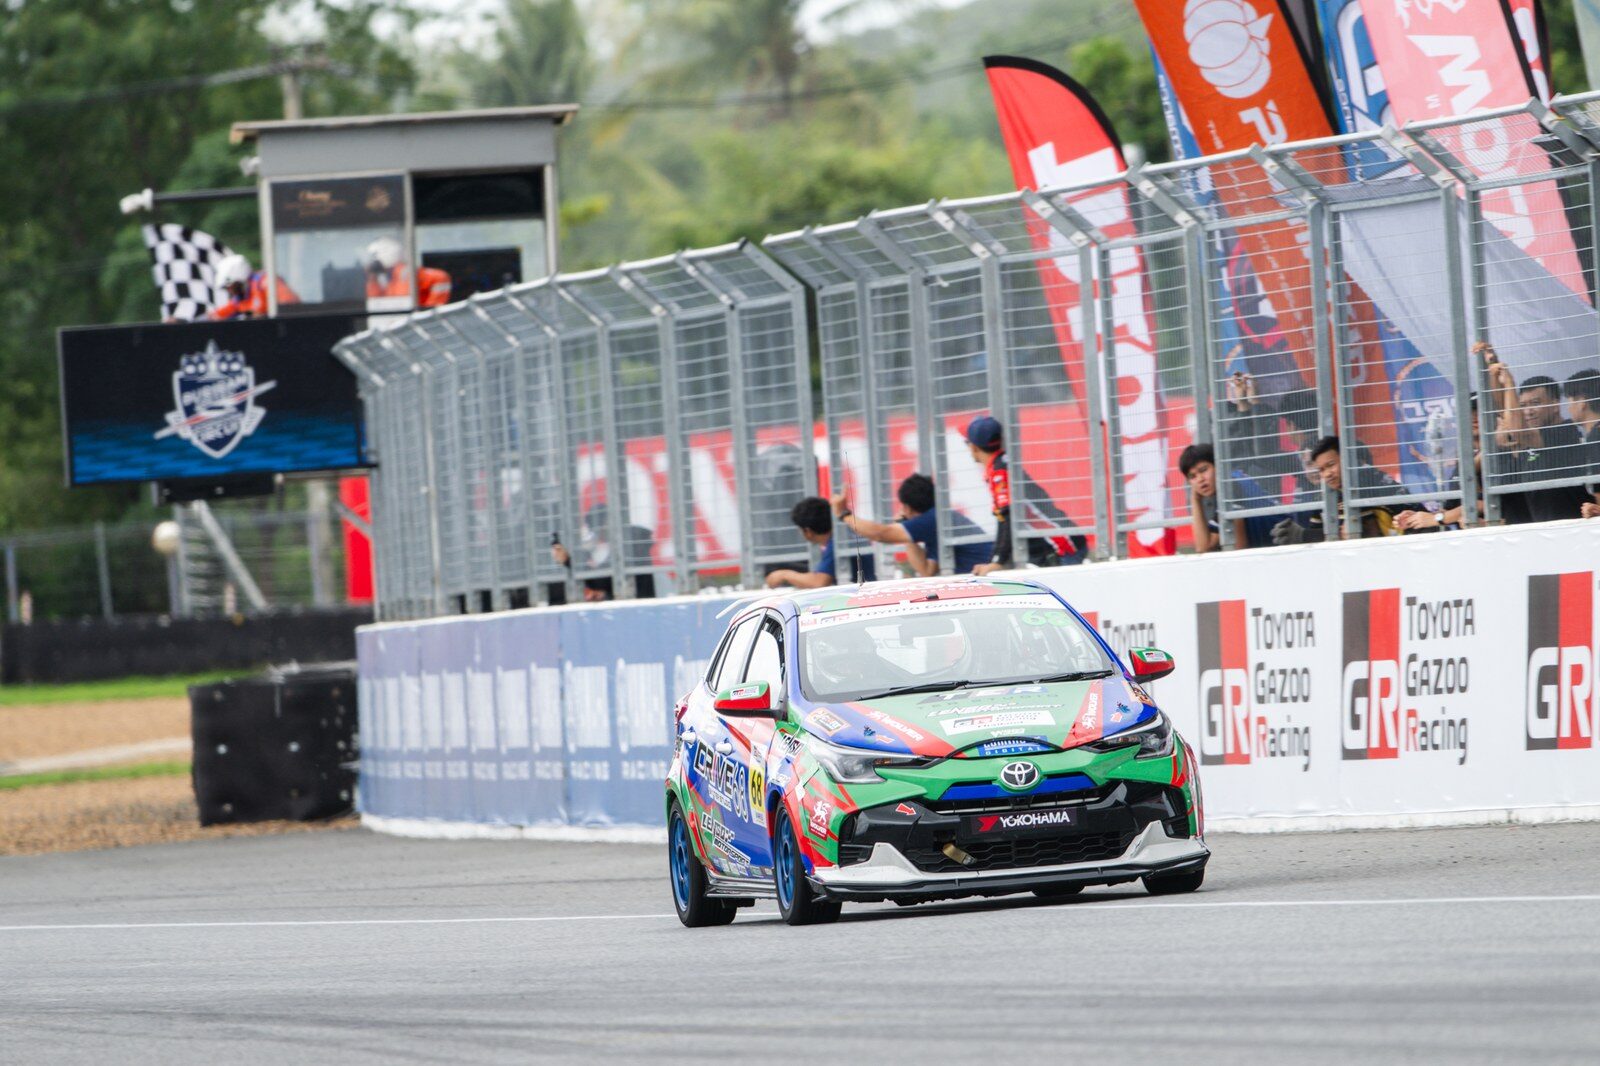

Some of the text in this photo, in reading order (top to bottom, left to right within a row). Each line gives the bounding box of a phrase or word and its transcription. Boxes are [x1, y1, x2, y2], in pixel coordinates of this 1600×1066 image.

[1252, 607, 1316, 650] TOYOTA
[1406, 596, 1477, 641] TOYOTA
[1255, 661, 1312, 705] GAZOO
[1407, 652, 1469, 697] GAZOO
[1527, 645, 1593, 739] GR
[1200, 668, 1249, 756] GR
[1343, 659, 1400, 750] GR
[985, 746, 1042, 756] DIGITAL
[1257, 714, 1312, 771] Racing
[1406, 706, 1469, 766] Racing
[751, 769, 763, 807] 68
[1000, 811, 1070, 828] YOKOHAMA
